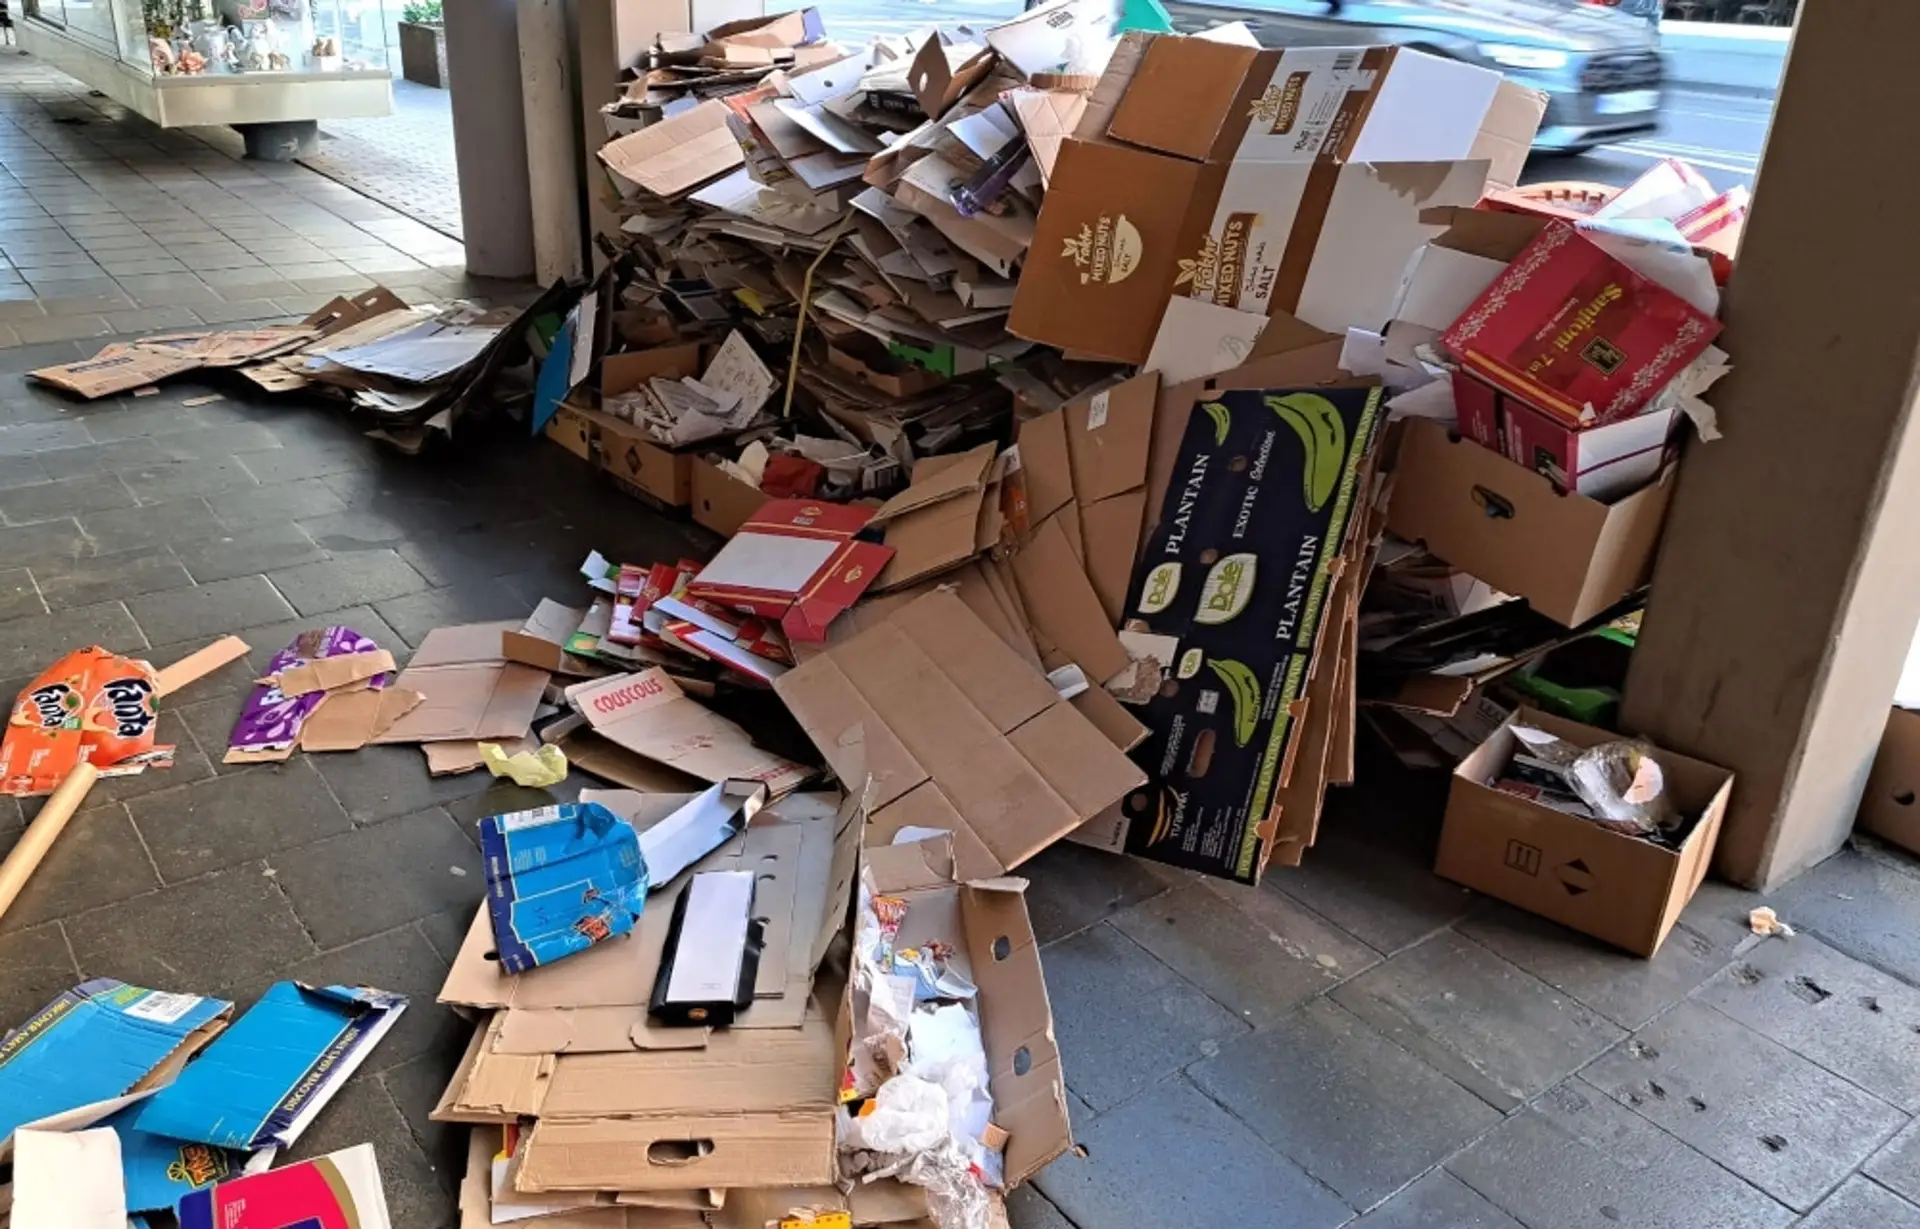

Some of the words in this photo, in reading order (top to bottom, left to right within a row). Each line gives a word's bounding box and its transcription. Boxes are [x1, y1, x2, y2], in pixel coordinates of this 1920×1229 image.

[1226, 219, 1244, 258] NUTS
[1255, 265, 1276, 300] SALT
[1164, 452, 1211, 556] PLANTAIN
[1232, 484, 1260, 540] EXOTIC
[1147, 567, 1174, 606] Dole
[1207, 559, 1246, 612] Dole
[1275, 534, 1319, 641] PLANTAIN
[31, 683, 69, 727] Fanta
[103, 677, 154, 738] Fanta
[593, 678, 664, 714] COUSCOUS
